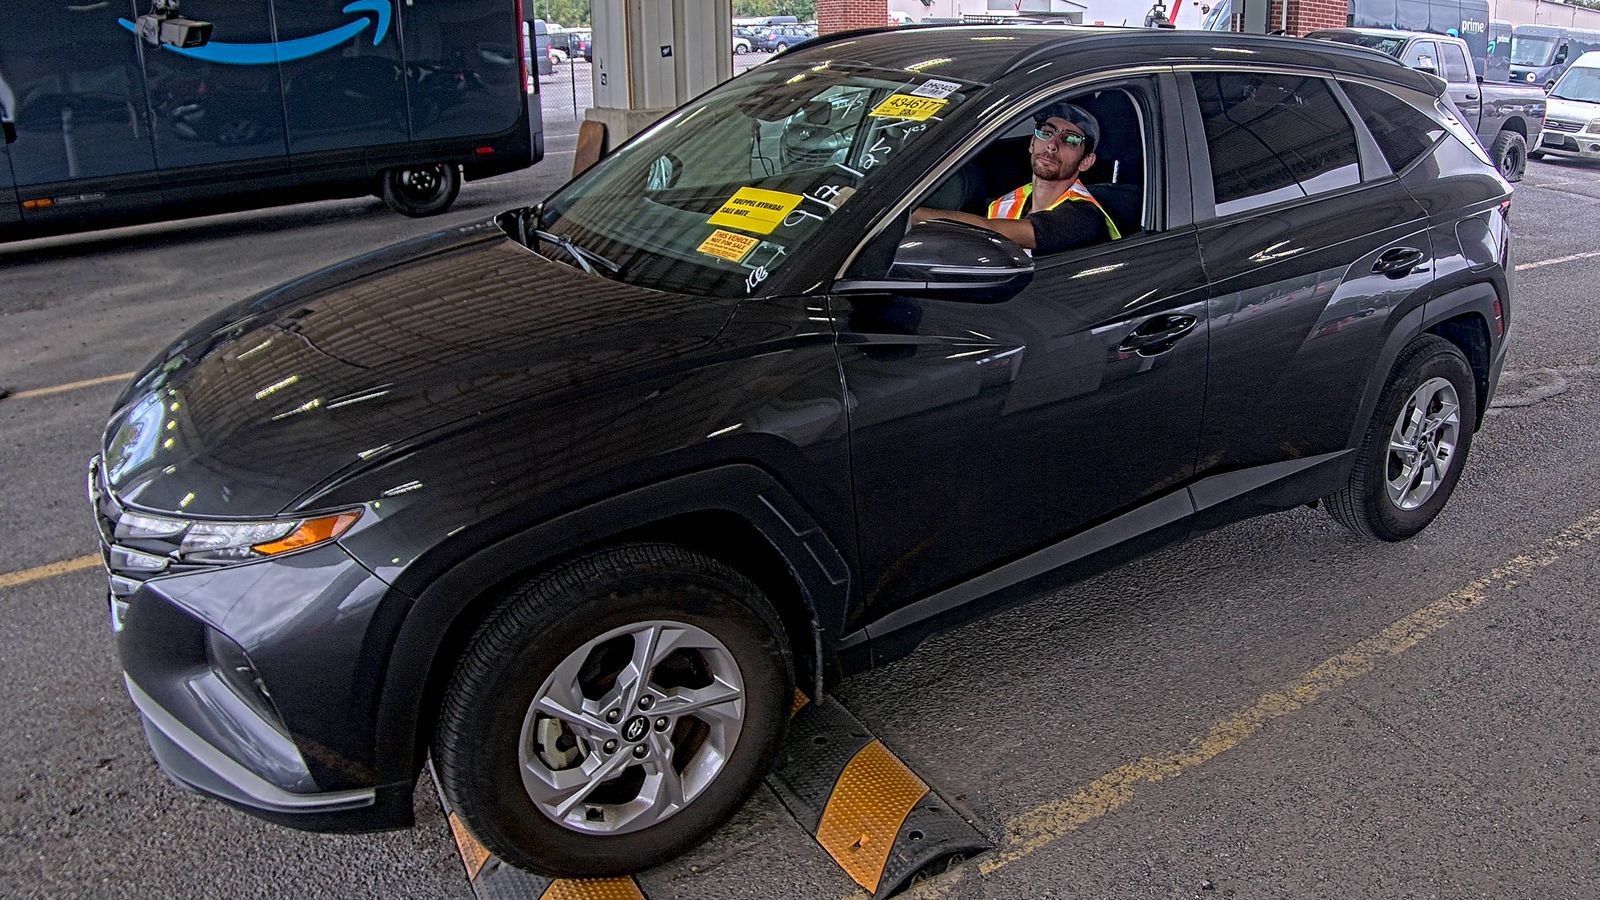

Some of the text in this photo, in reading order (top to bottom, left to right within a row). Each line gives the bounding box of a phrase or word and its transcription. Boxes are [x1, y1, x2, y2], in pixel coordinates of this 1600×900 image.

[1462, 17, 1485, 34] prime
[1496, 34, 1511, 44] prime
[890, 97, 944, 111] 4346177
[720, 207, 735, 215] SALE
[754, 202, 784, 212] HYUNDAI
[710, 237, 723, 245] NOT
[714, 231, 754, 246] THIS VEHICLE
